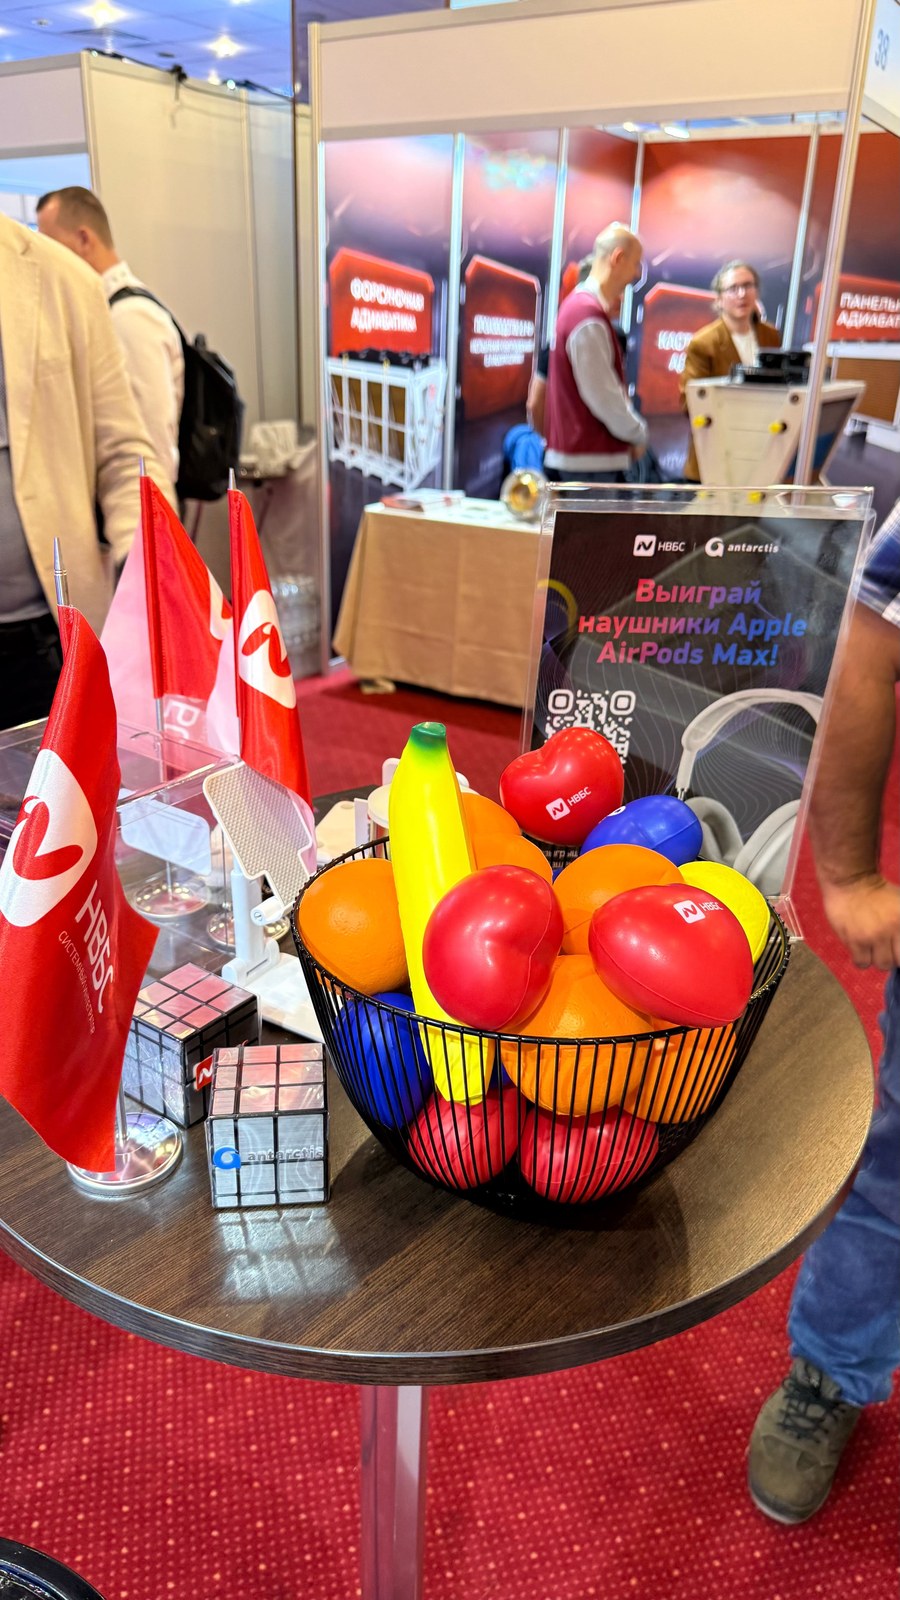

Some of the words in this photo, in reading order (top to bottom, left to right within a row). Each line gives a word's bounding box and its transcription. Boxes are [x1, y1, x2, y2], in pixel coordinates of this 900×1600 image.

[657, 541, 686, 552] НВБС
[727, 542, 779, 554] antarctis
[635, 578, 762, 609] Выиграй
[578, 615, 721, 638] наушники
[727, 612, 808, 642] Apple
[597, 641, 704, 665] AirPods
[711, 643, 779, 666] Max!
[567, 786, 592, 806] НВБС
[75, 879, 114, 1014] НВБС
[248, 1145, 324, 1161] antarctis
